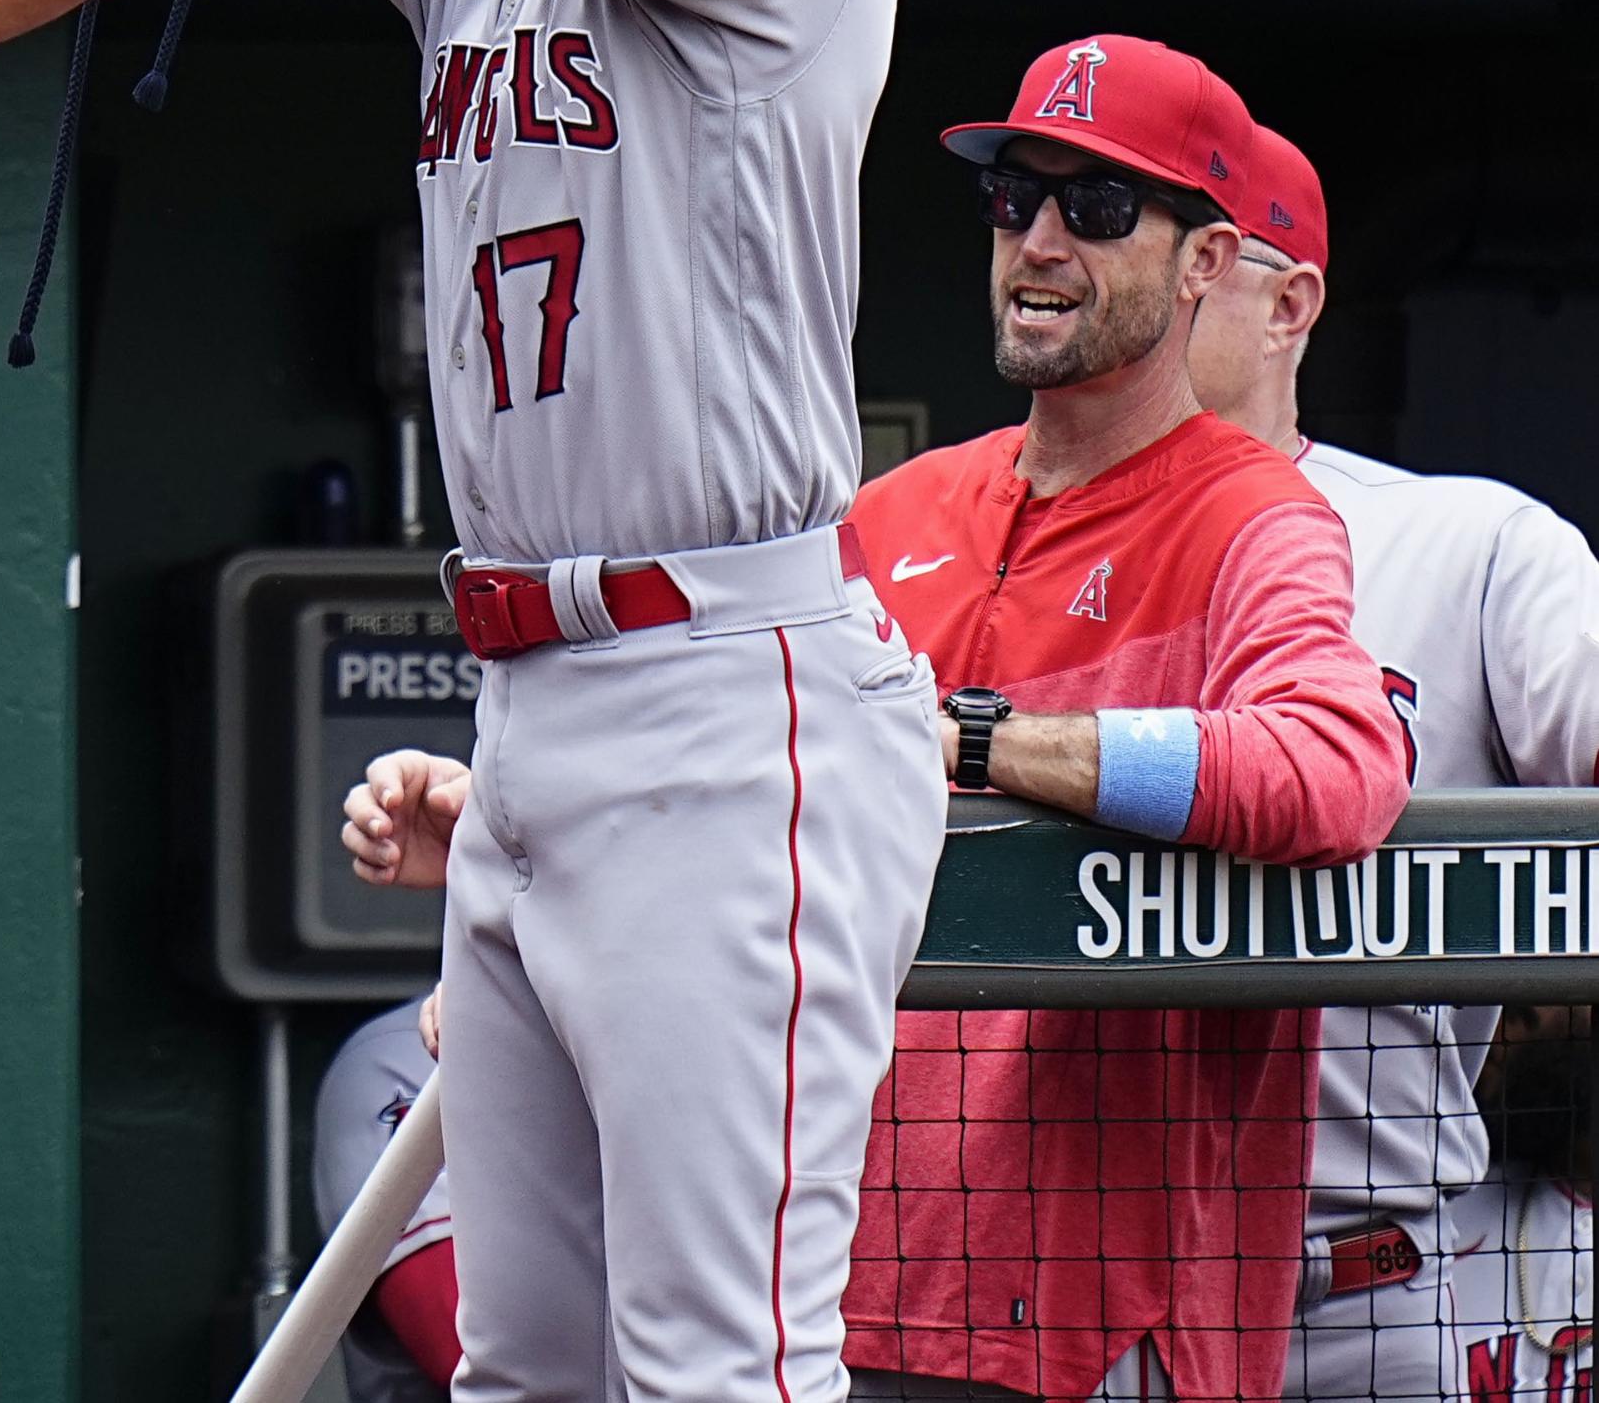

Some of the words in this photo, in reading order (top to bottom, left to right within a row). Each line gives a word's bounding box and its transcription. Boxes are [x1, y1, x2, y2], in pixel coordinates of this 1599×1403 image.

[471, 217, 586, 414] 17
[346, 614, 418, 636] PRESS
[425, 614, 461, 636] BO
[337, 653, 482, 701] PRESS
[1483, 850, 1599, 954] TH
